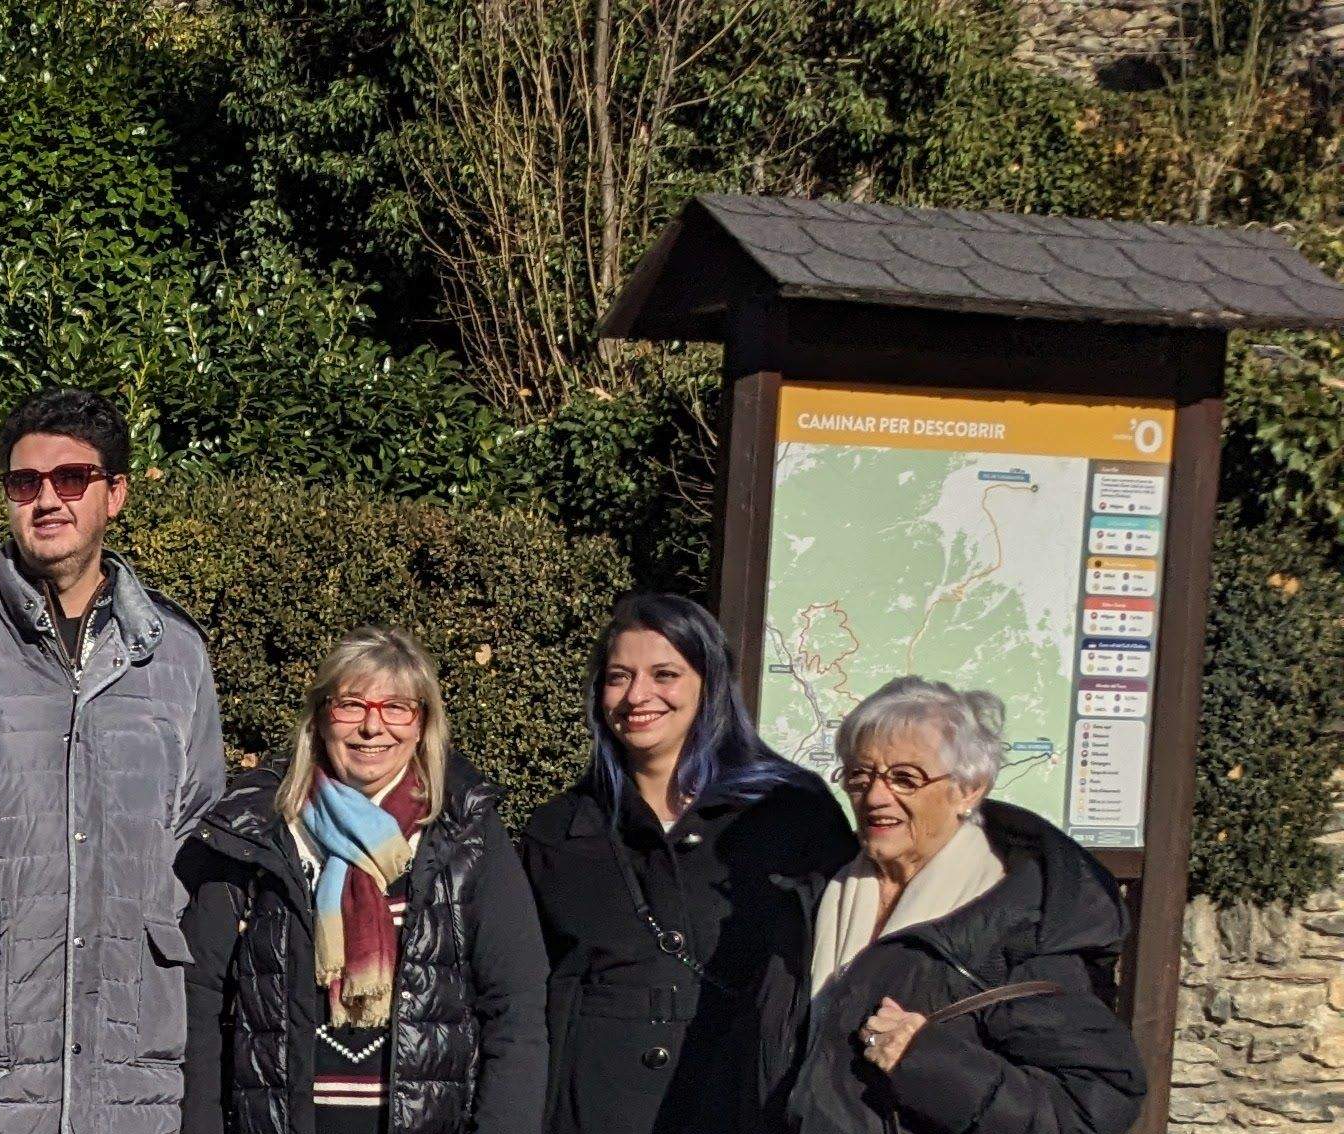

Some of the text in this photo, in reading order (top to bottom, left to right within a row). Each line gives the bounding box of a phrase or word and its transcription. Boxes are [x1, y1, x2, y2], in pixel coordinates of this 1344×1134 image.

[797, 413, 1006, 440] CAMINAR PER DESCOBRIR
